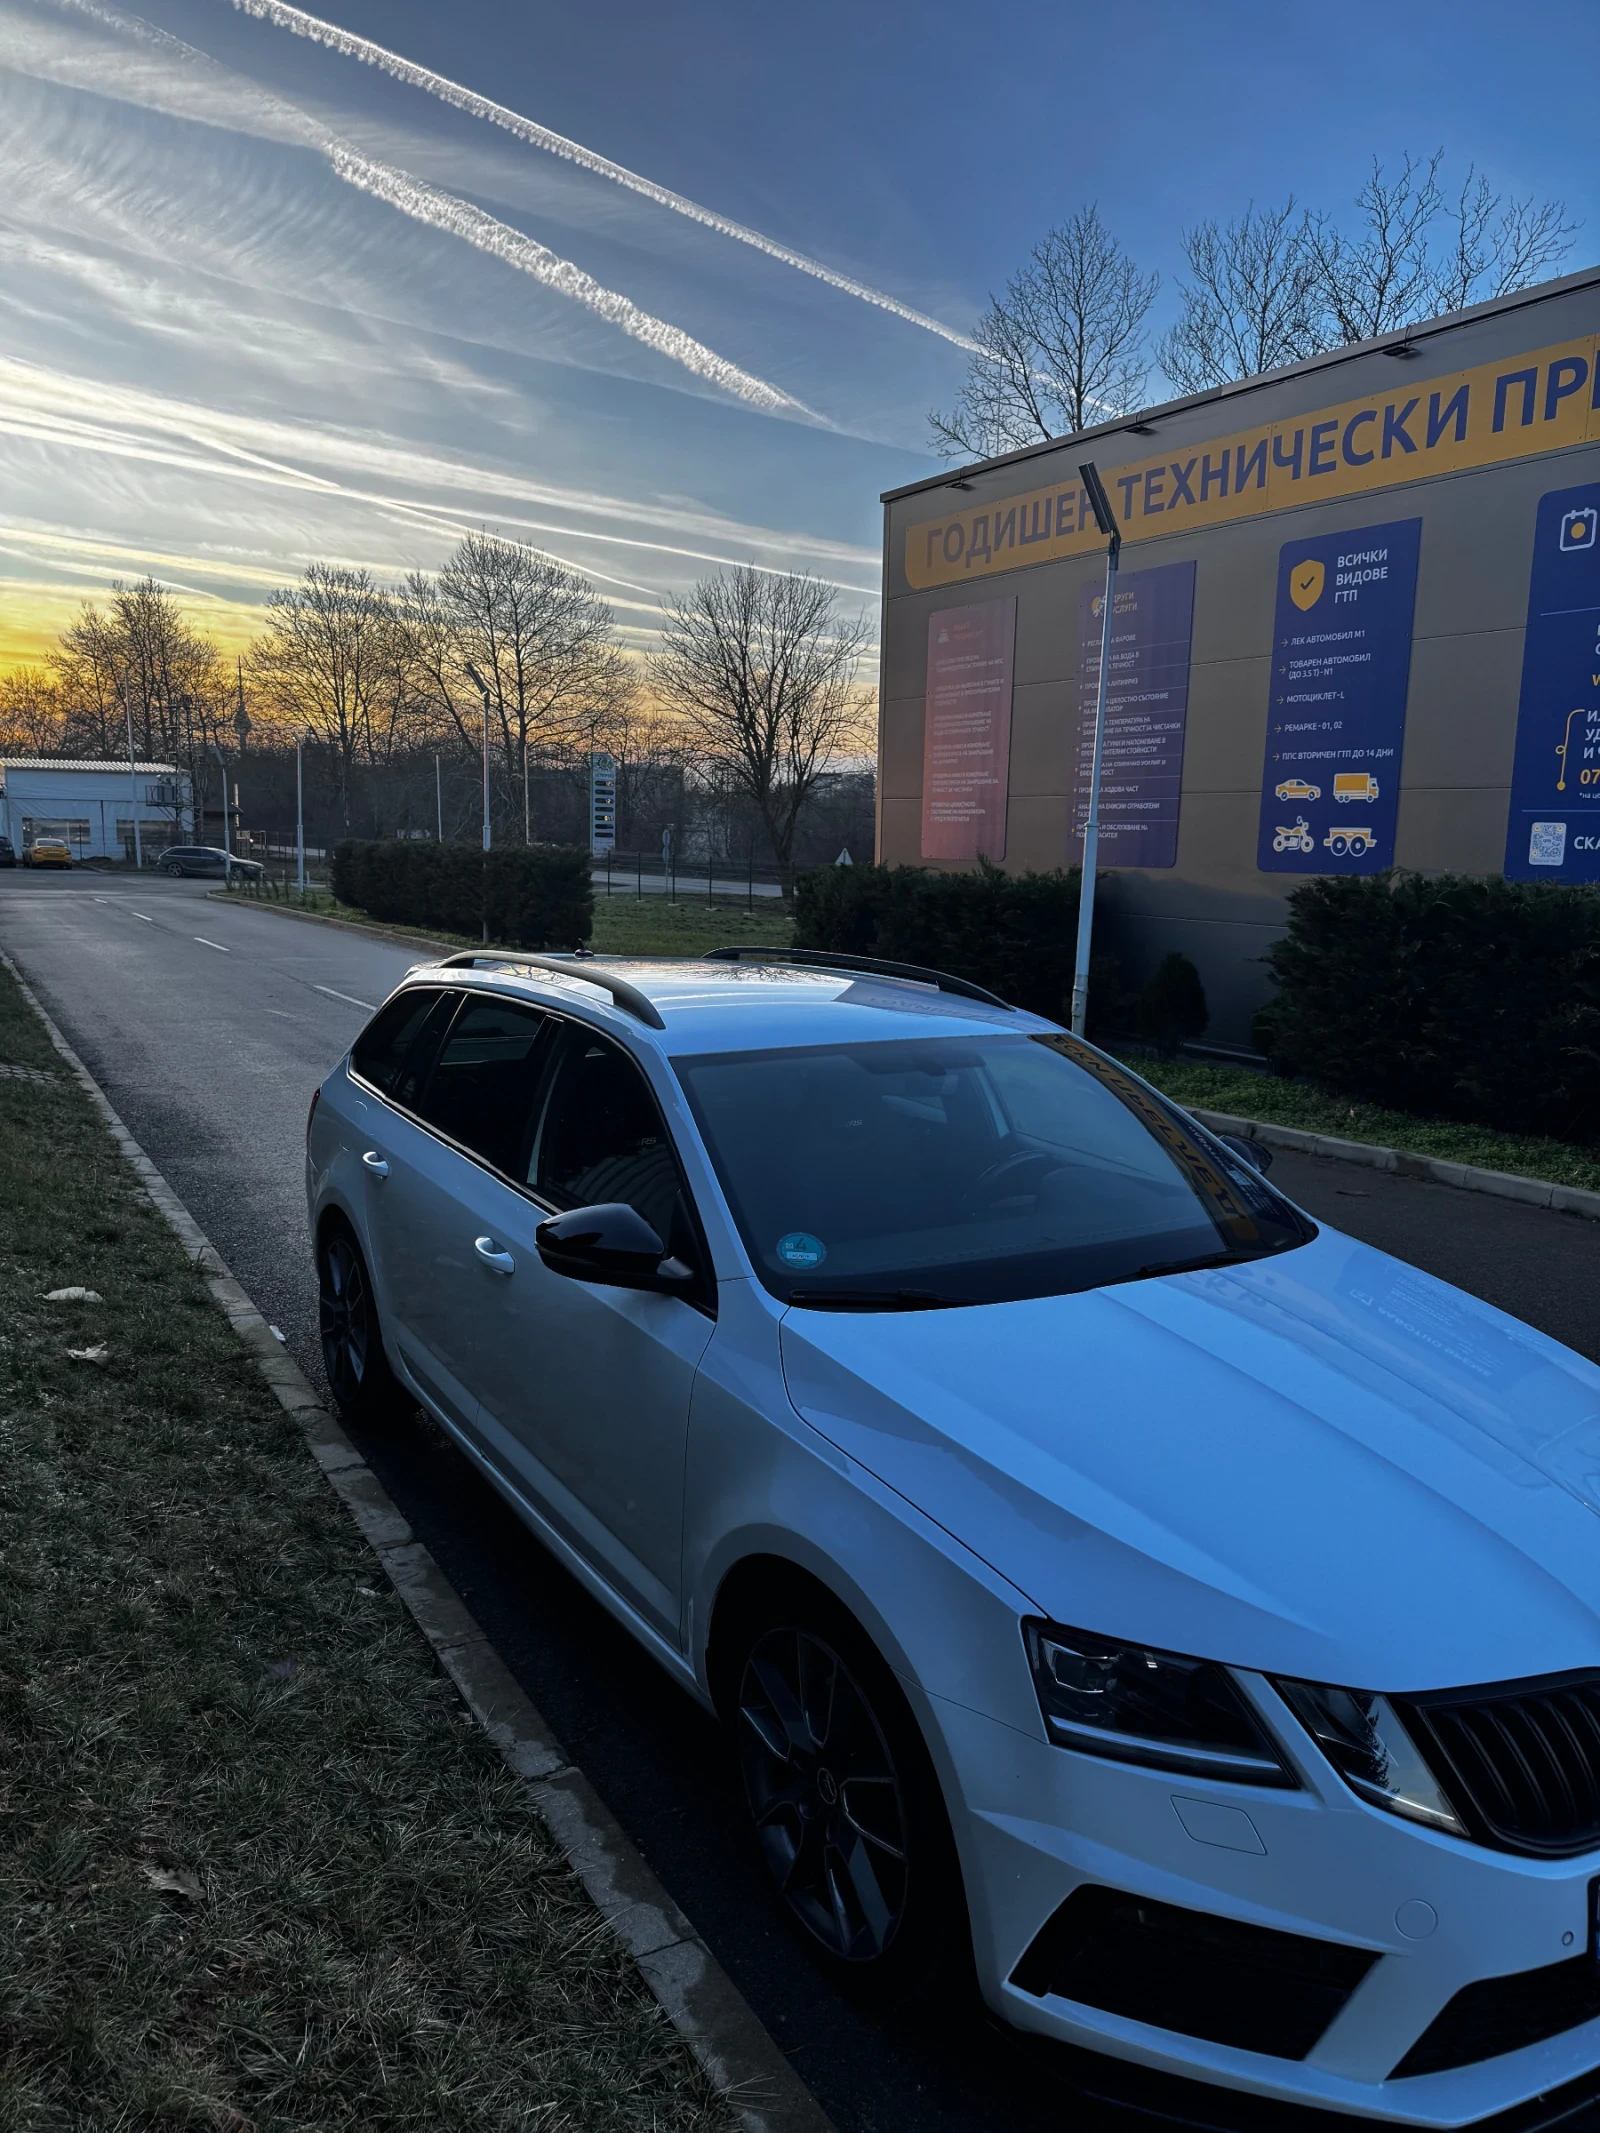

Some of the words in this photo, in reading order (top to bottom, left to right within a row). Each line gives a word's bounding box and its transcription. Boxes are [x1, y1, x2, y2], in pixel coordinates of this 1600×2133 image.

[1118, 384, 1470, 520] ТЕХНИЧЕСКИ
[1492, 350, 1600, 433] ПР
[1337, 548, 1388, 568] ВСИЧКИ
[1336, 567, 1388, 586] ВИДОВЕ
[1334, 590, 1358, 604] ГТП
[1290, 636, 1305, 646] ЛЕК
[1306, 631, 1353, 644] АВТОМОБИЛ
[1289, 658, 1322, 669] ТОВАРЕН
[1322, 653, 1371, 666] АВТОМОБИЛ
[1284, 722, 1317, 732] РЕМАРКЕ
[1297, 751, 1335, 760] ВТОРИЧЕН
[1352, 750, 1364, 759] ДО
[1375, 748, 1393, 758] ДНИ
[796, 1237, 806, 1251] 4
